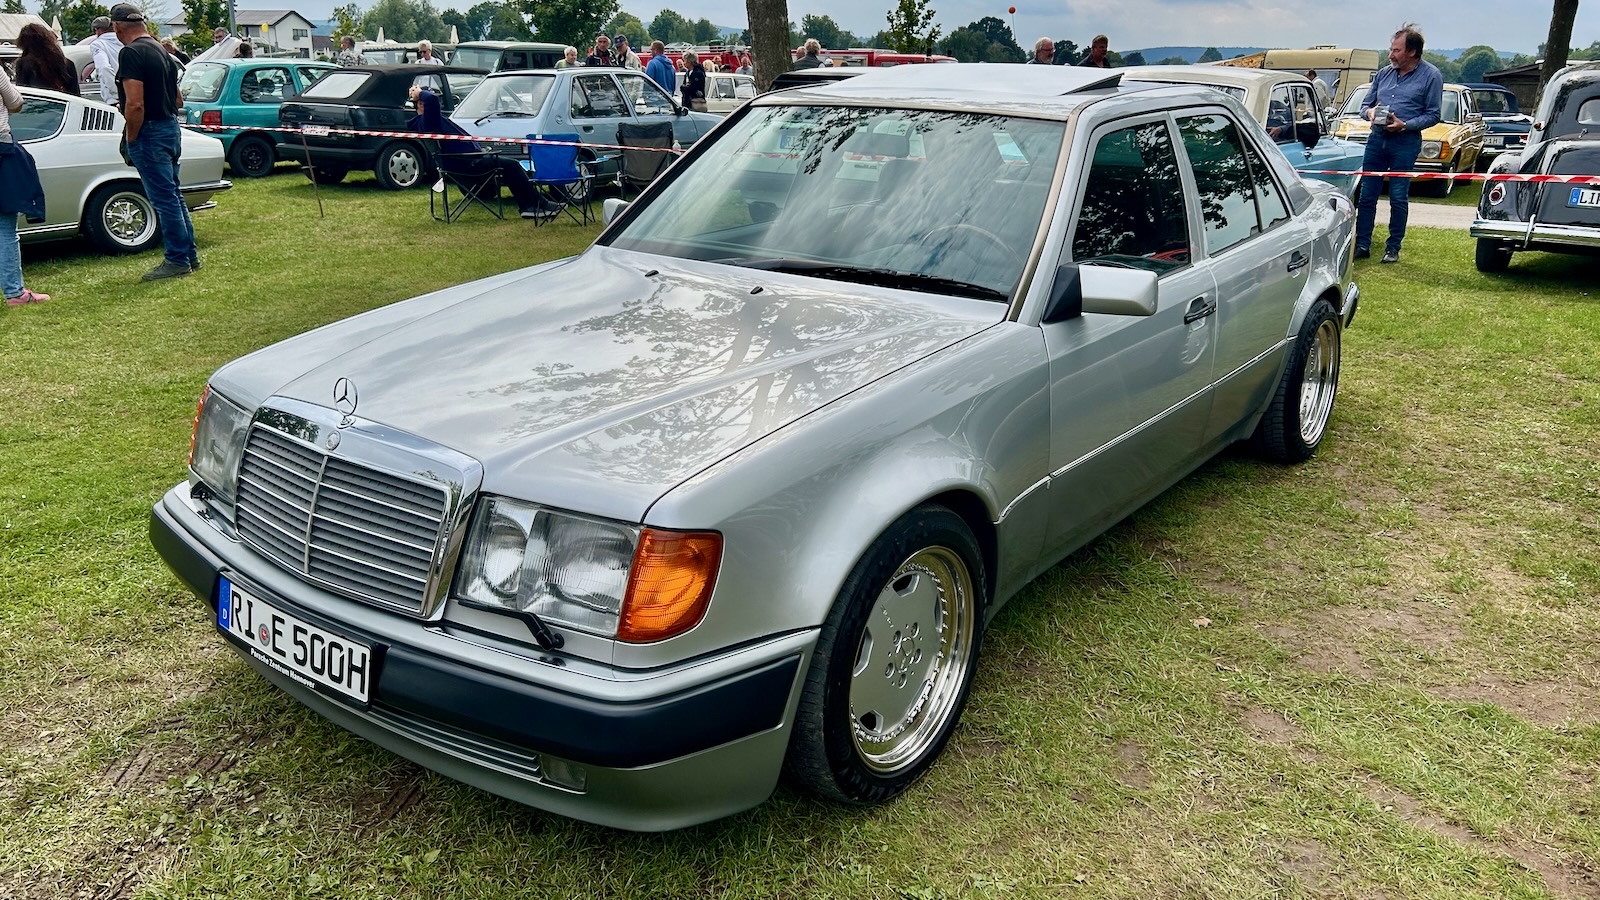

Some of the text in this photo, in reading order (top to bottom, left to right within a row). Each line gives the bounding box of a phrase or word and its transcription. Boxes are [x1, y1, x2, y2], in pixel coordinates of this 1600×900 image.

[222, 608, 228, 620] D
[231, 589, 367, 694] RI E 500H
[250, 647, 315, 689] Porsche Zentrum Hannover
